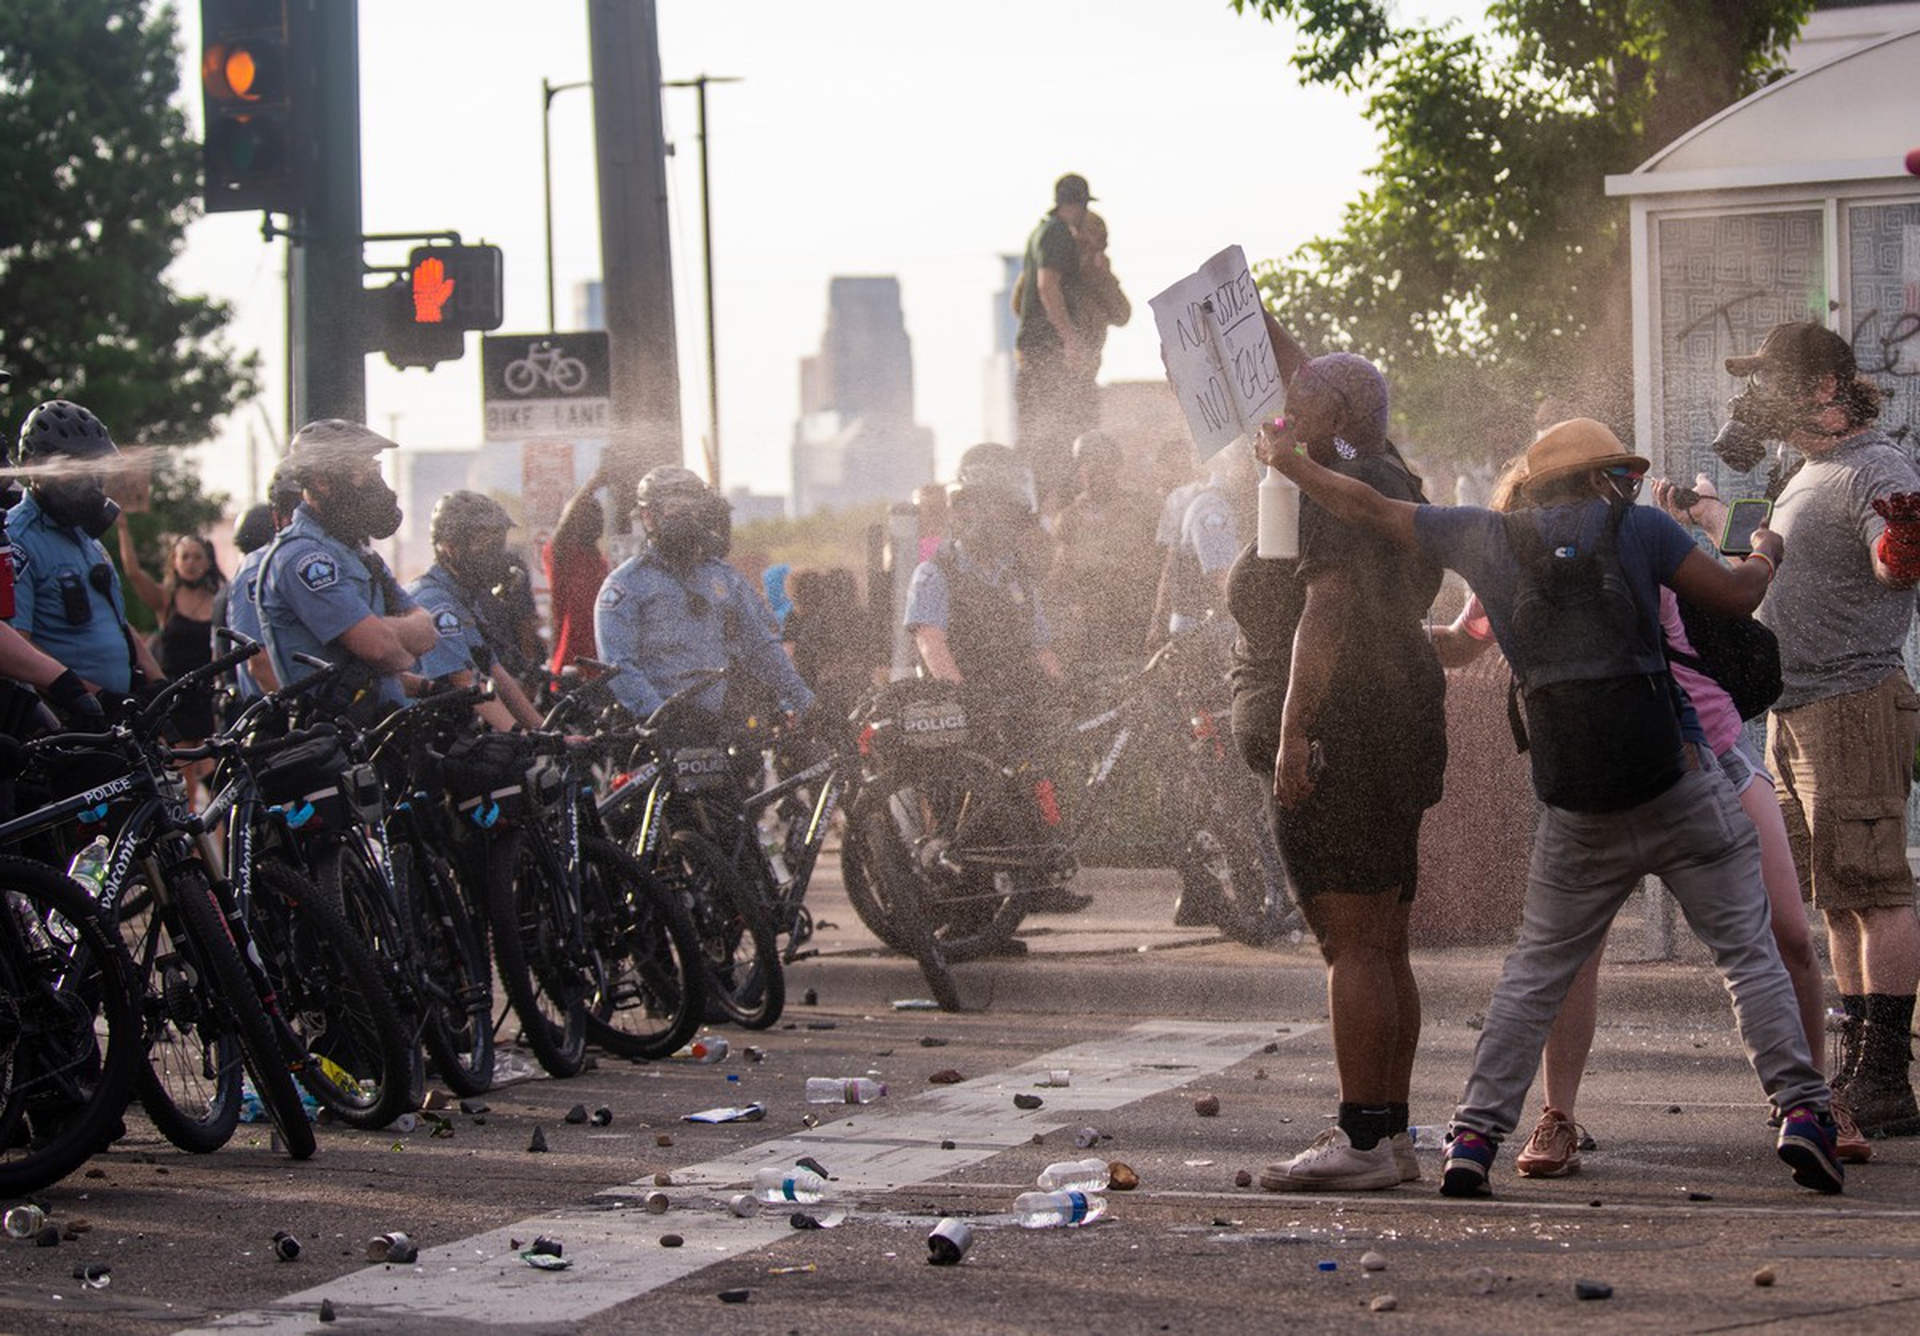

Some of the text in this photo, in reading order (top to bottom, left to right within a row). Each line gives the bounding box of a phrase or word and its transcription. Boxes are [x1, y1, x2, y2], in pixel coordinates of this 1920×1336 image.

[1177, 301, 1208, 351] NO
[486, 402, 606, 431] BIKE LANE
[1196, 375, 1230, 433] NO
[84, 777, 132, 805] POLICE
[100, 831, 139, 910] volcanic
